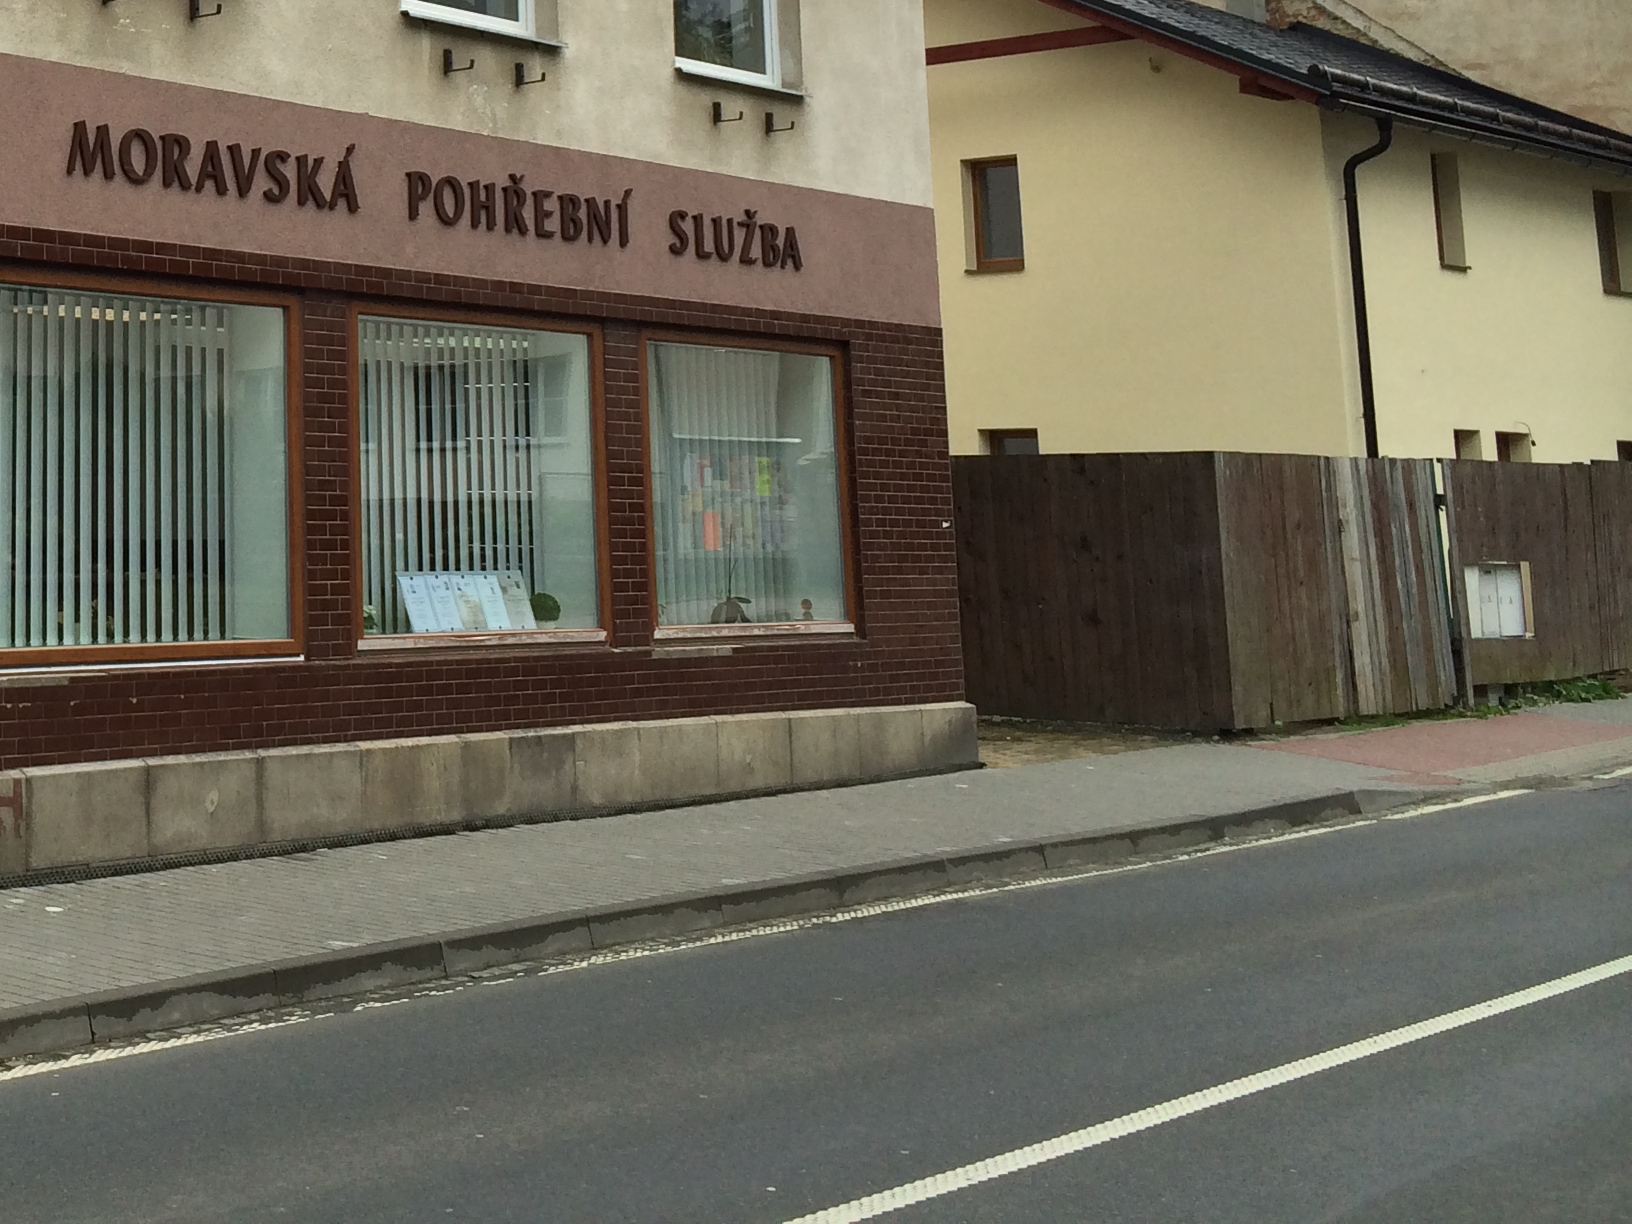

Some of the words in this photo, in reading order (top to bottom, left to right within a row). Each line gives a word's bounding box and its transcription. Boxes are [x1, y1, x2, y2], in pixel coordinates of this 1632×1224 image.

[67, 119, 360, 214] MORAVSKÁ
[404, 173, 634, 248] POHŘEBNÍ
[668, 209, 803, 270] SLUŽBA
